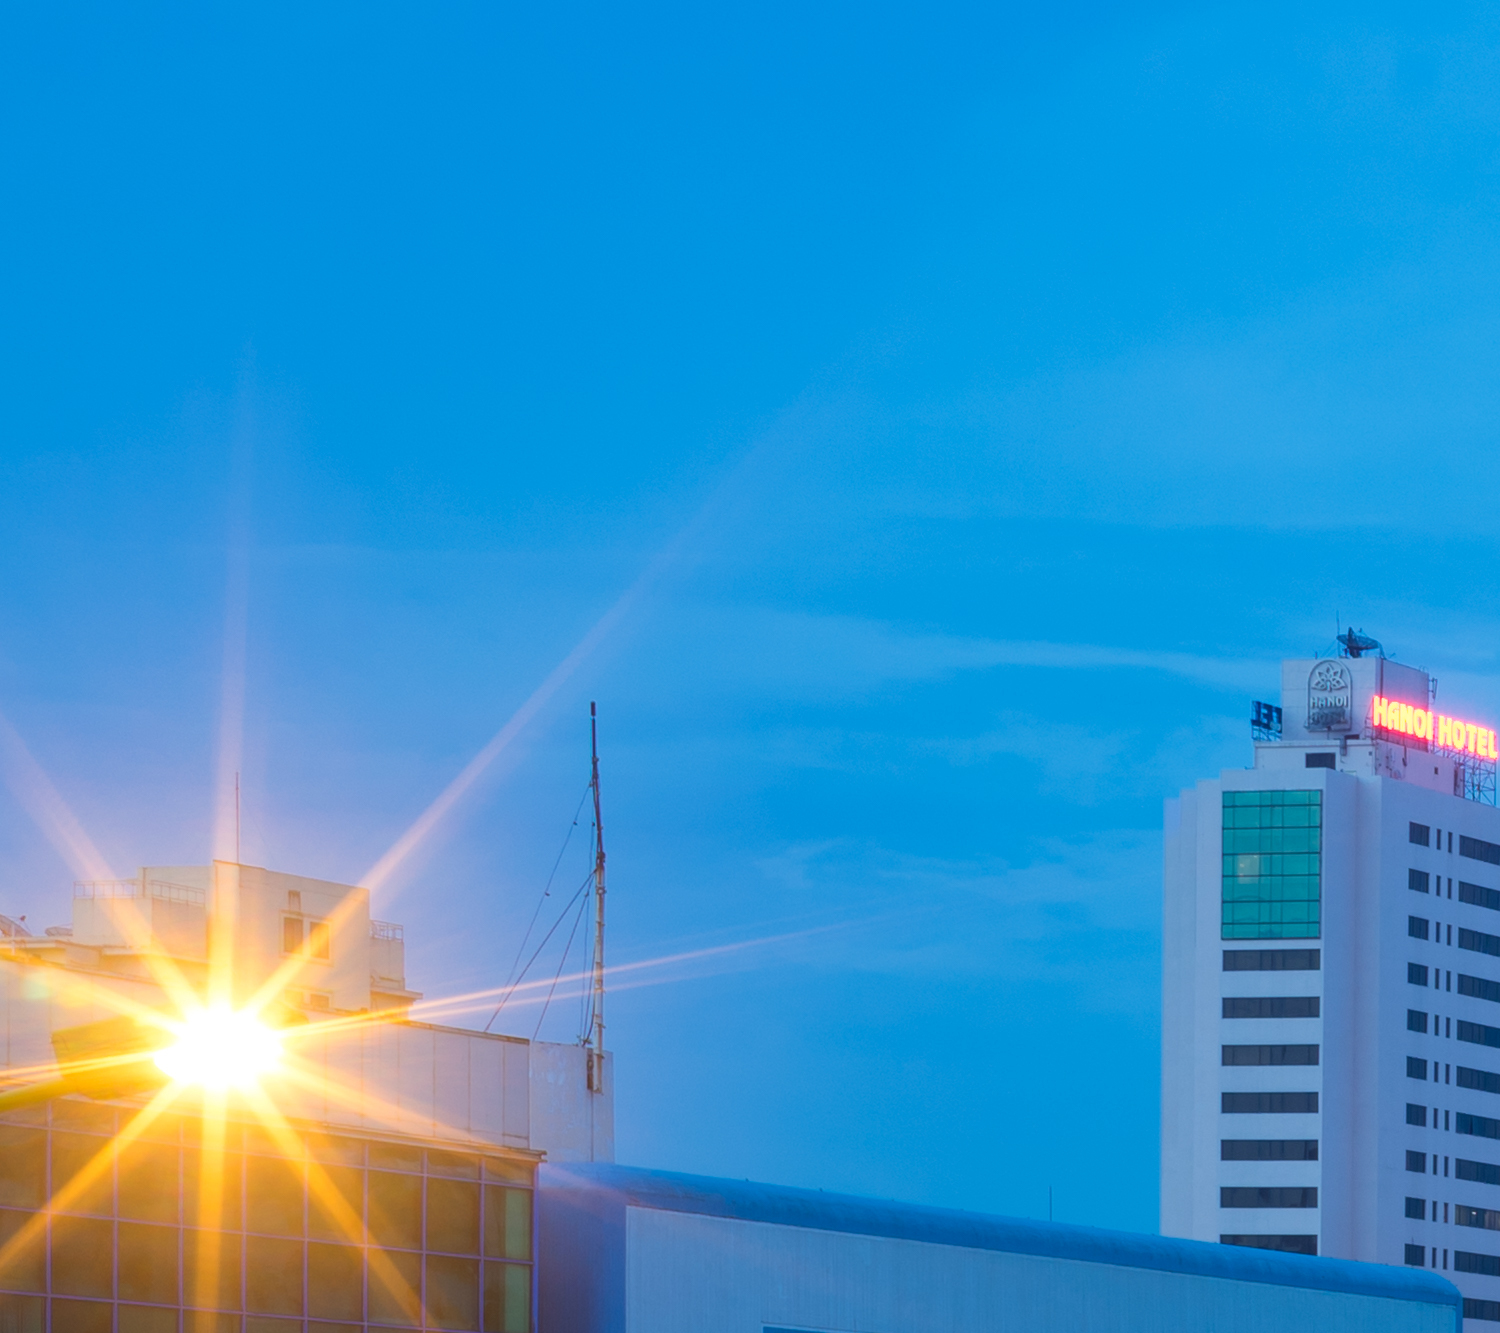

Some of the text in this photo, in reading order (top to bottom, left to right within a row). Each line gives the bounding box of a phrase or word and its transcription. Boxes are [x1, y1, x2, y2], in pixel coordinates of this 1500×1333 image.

[1310, 695, 1349, 709] HANOI
[1373, 695, 1499, 760] HANOI HOTEL
